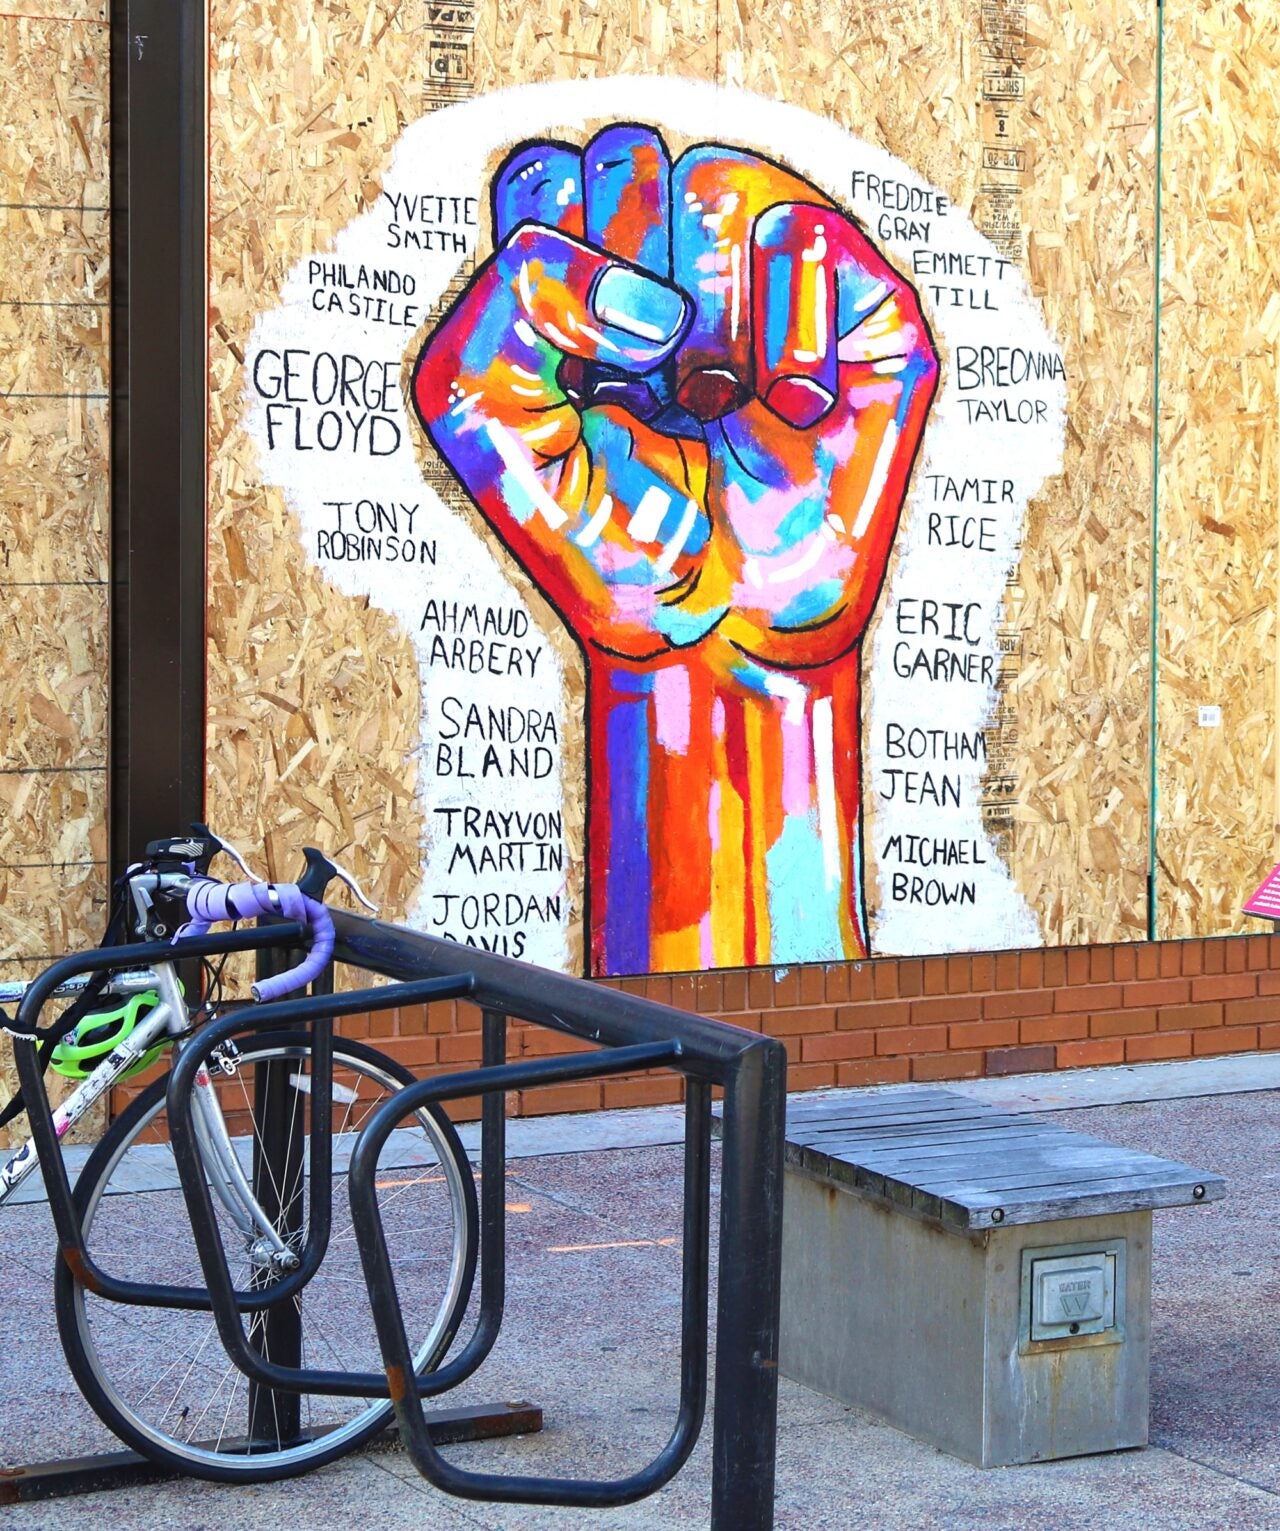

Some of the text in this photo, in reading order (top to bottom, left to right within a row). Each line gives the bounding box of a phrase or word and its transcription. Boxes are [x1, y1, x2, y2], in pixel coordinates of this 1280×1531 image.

[384, 192, 479, 226] YVETTE
[851, 171, 948, 217] FREDDIE
[387, 224, 468, 253] SMITH
[877, 213, 931, 243] GRAY
[308, 260, 416, 296] PHILANDO
[913, 250, 1012, 280] EMMETT
[311, 288, 420, 328] CASTILE
[929, 285, 1000, 311] TILL
[252, 349, 402, 413] GEORGE
[956, 346, 1067, 392] BREONNA
[265, 403, 402, 456] FLOYD
[957, 399, 1049, 425] TAYLOR
[925, 475, 1015, 504] TAMIR
[323, 500, 419, 535] TONY
[927, 513, 997, 552] RICE
[317, 530, 437, 565] ROBINSON
[420, 599, 529, 638] AHMAUD
[896, 598, 982, 646] ERIC
[429, 635, 542, 678] ARBERY
[893, 641, 995, 685] GARNER
[438, 696, 559, 745] SANDRA
[885, 723, 988, 761] BOTHAM
[436, 743, 554, 780] BLAND
[880, 768, 962, 808] JEAN
[433, 806, 562, 840] TRAYVON
[448, 841, 563, 876] MARTIN
[882, 835, 986, 867] MICHAEL
[892, 873, 976, 906] BROWN
[433, 893, 562, 930] JORDAN
